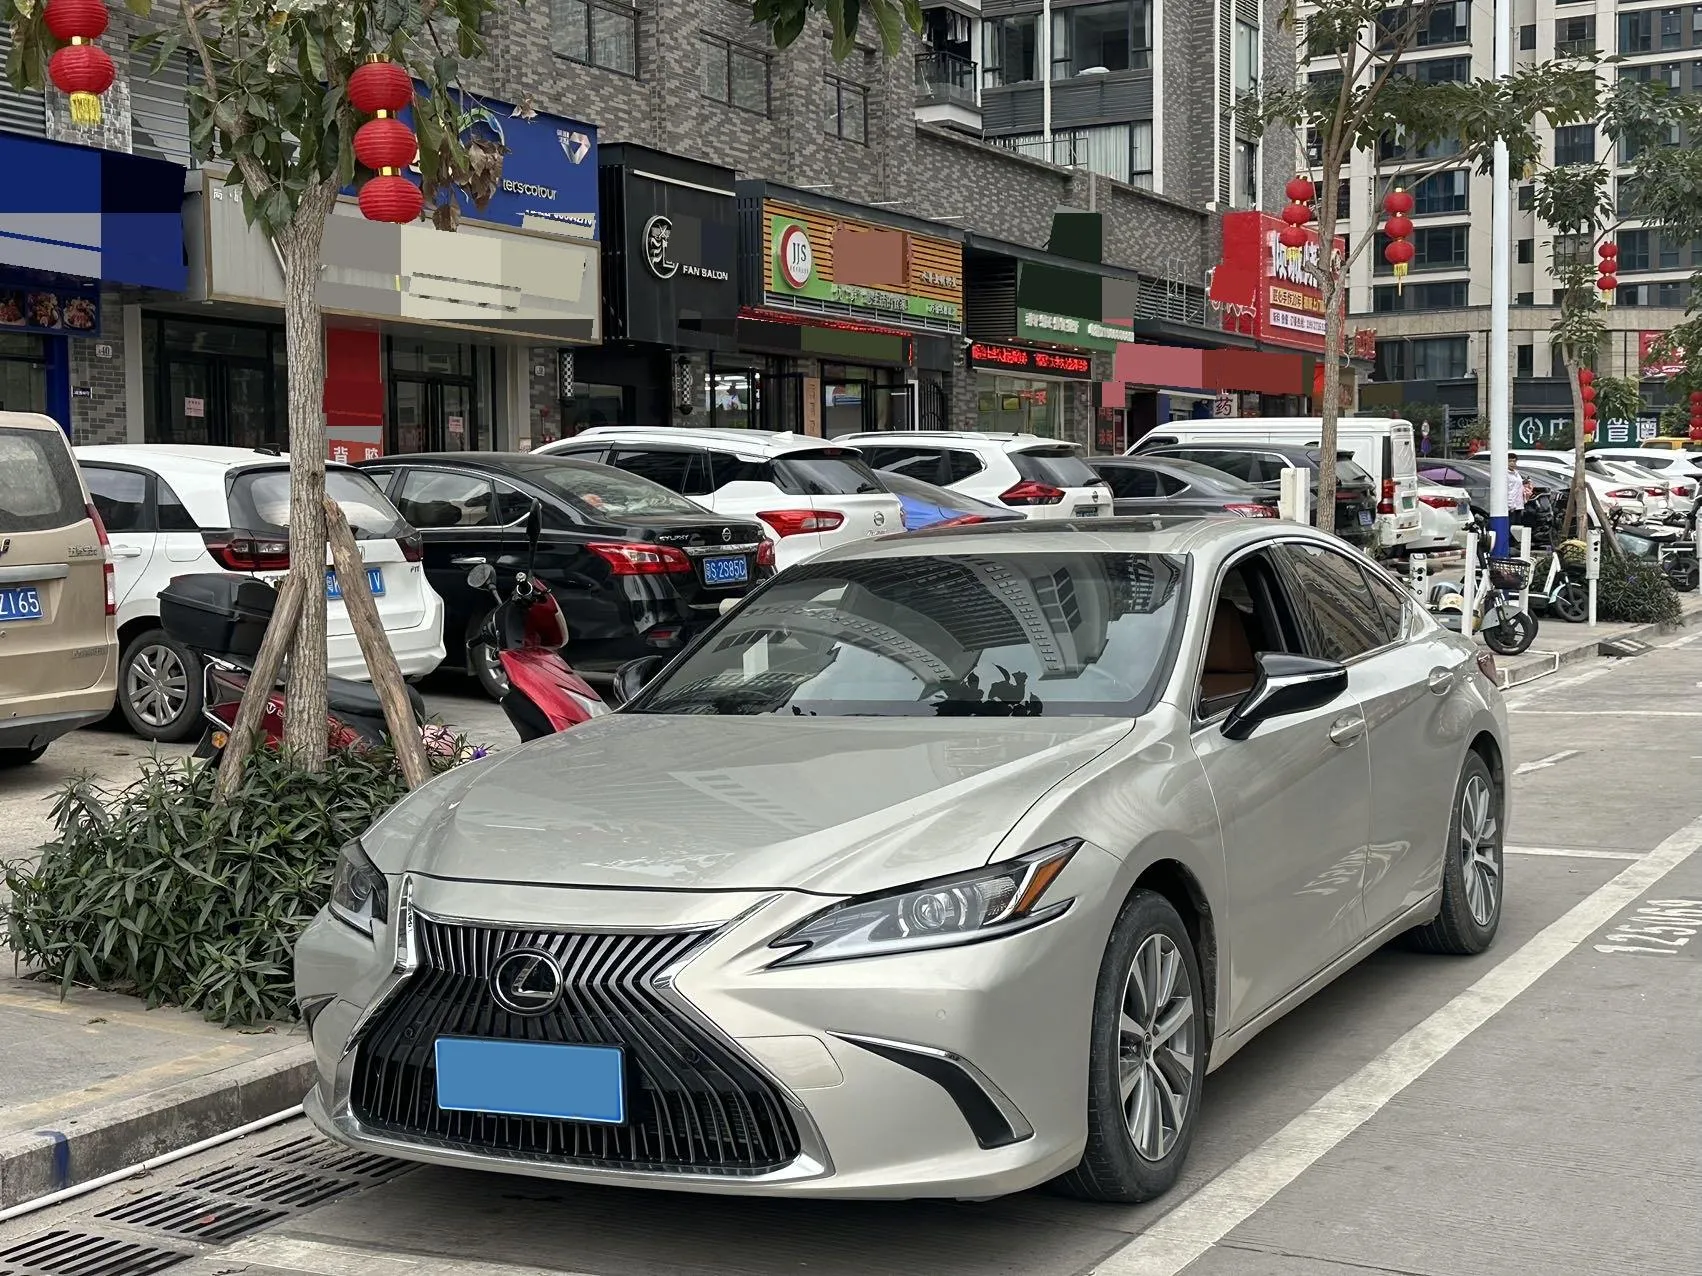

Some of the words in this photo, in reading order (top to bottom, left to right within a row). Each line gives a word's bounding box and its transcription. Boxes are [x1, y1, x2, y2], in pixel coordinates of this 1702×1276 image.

[792, 242, 807, 265] JJS
[682, 264, 700, 277] FAN
[701, 268, 729, 281] SALON
